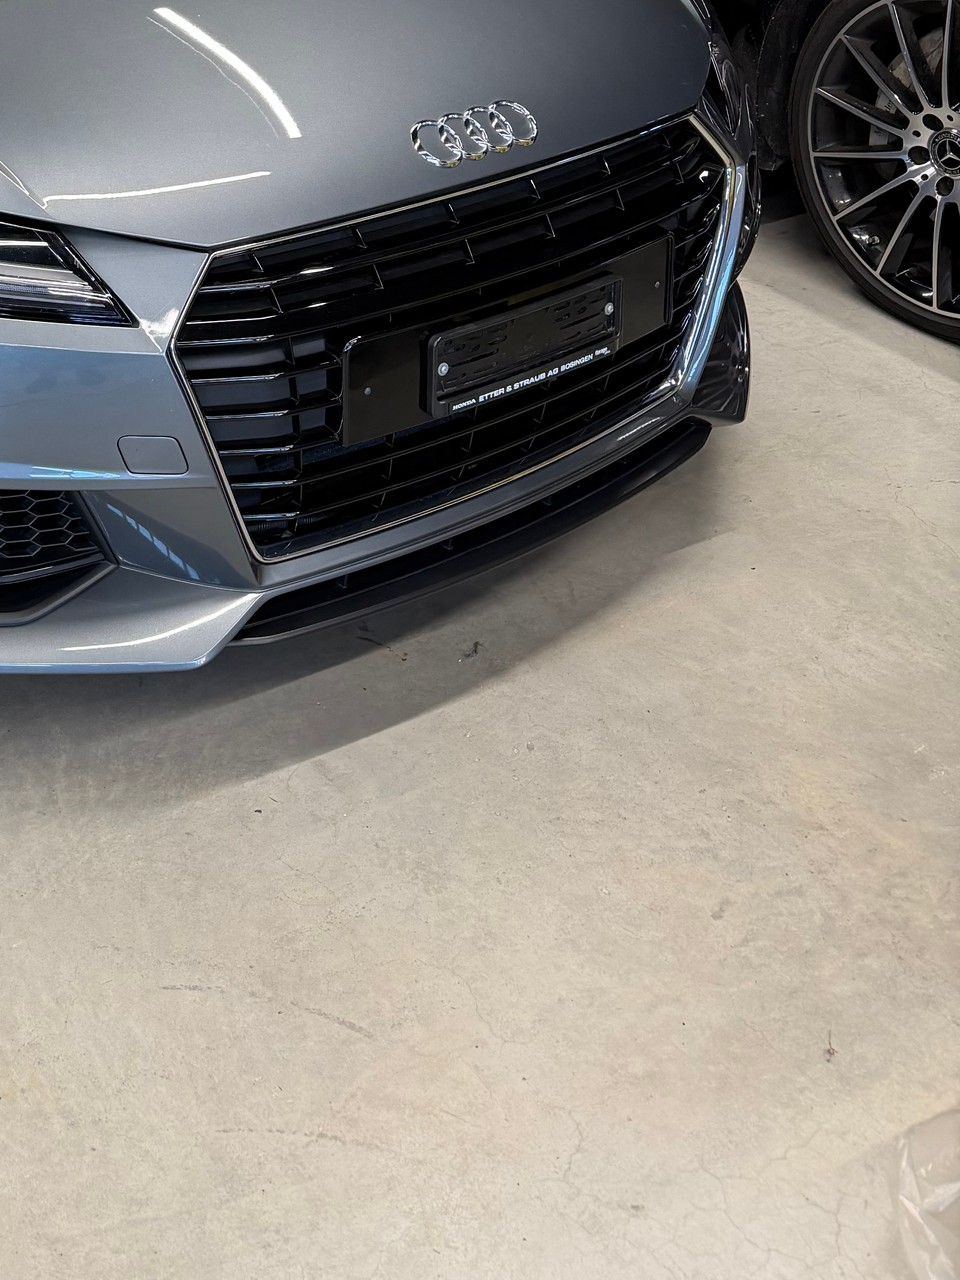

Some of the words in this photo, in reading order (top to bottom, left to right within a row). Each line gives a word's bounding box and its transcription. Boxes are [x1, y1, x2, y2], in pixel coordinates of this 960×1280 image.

[452, 398, 477, 411] HONDA
[478, 387, 505, 402] ETTER
[505, 384, 513, 393] &
[513, 372, 546, 390] STRAUB
[546, 367, 559, 377] AG
